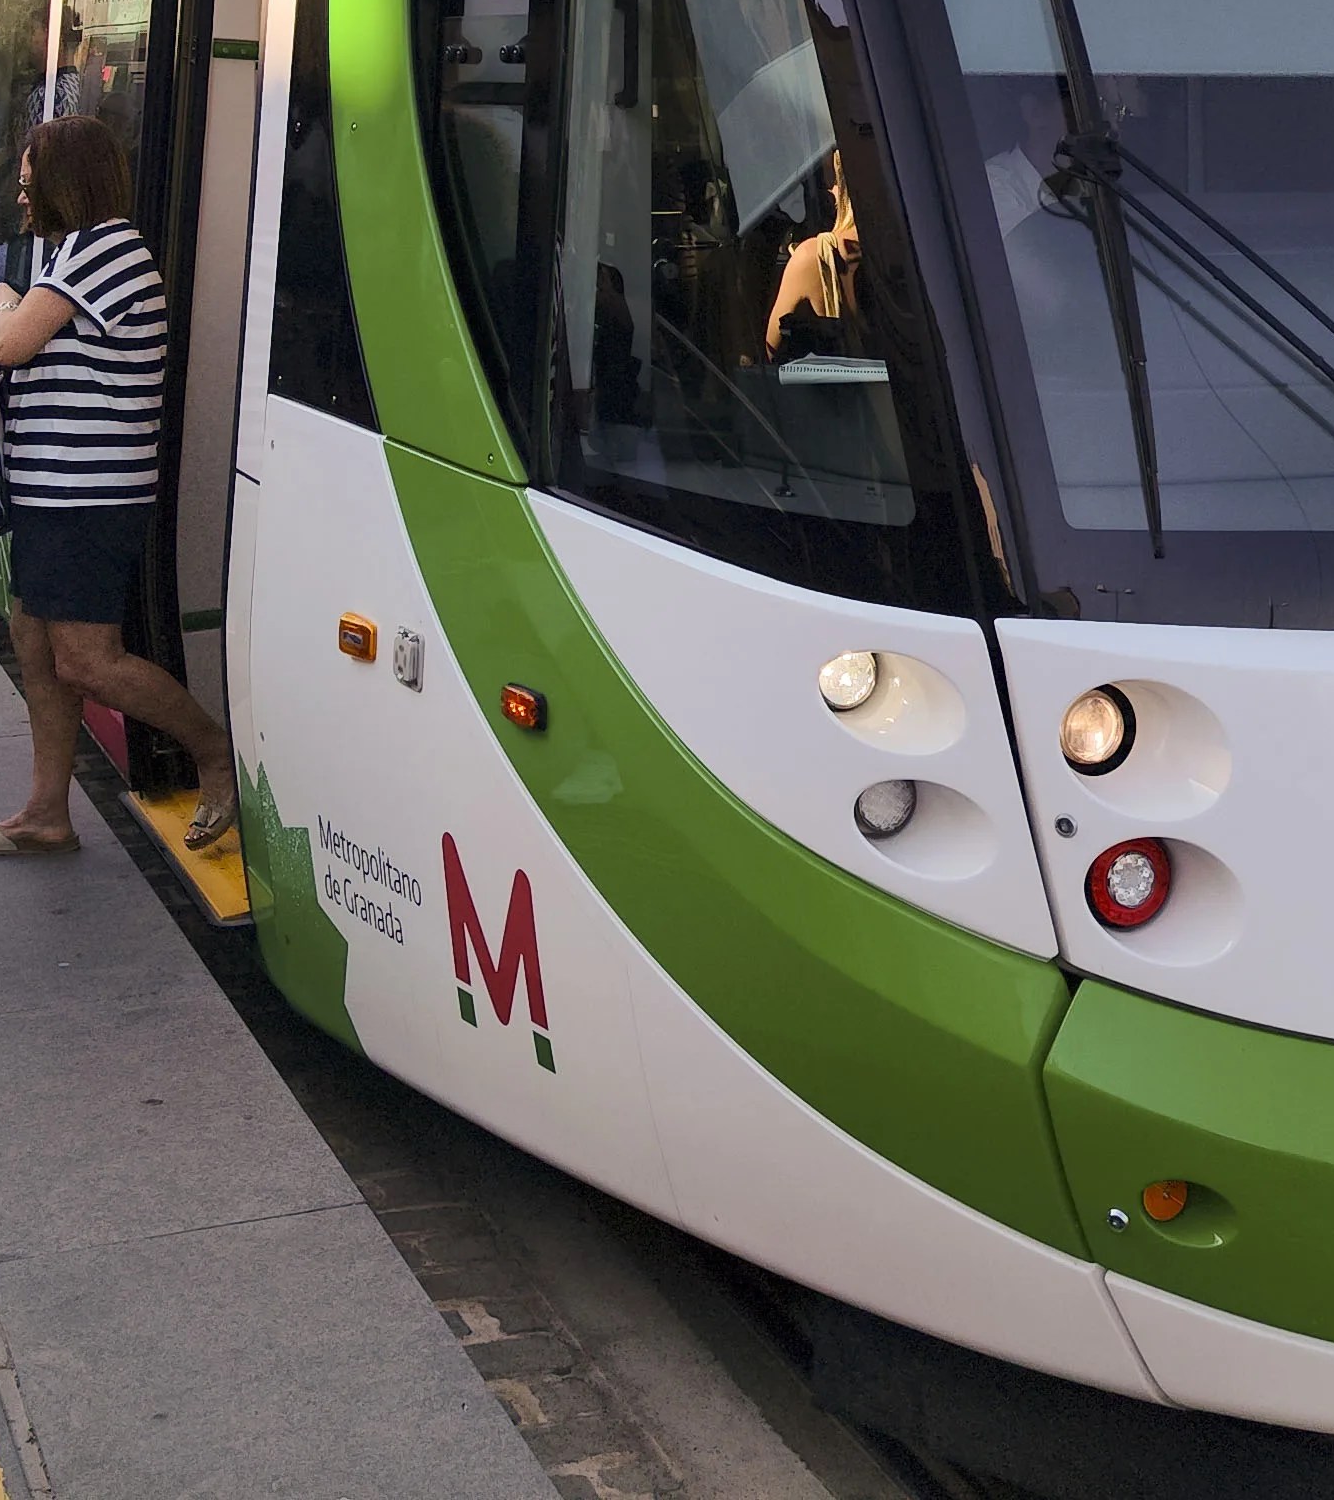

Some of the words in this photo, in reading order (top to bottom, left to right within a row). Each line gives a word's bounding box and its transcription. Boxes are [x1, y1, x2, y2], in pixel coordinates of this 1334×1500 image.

[318, 815, 422, 907] Metropolitano
[324, 865, 341, 907] de
[343, 879, 404, 946] Granada
[442, 831, 556, 1074] M
